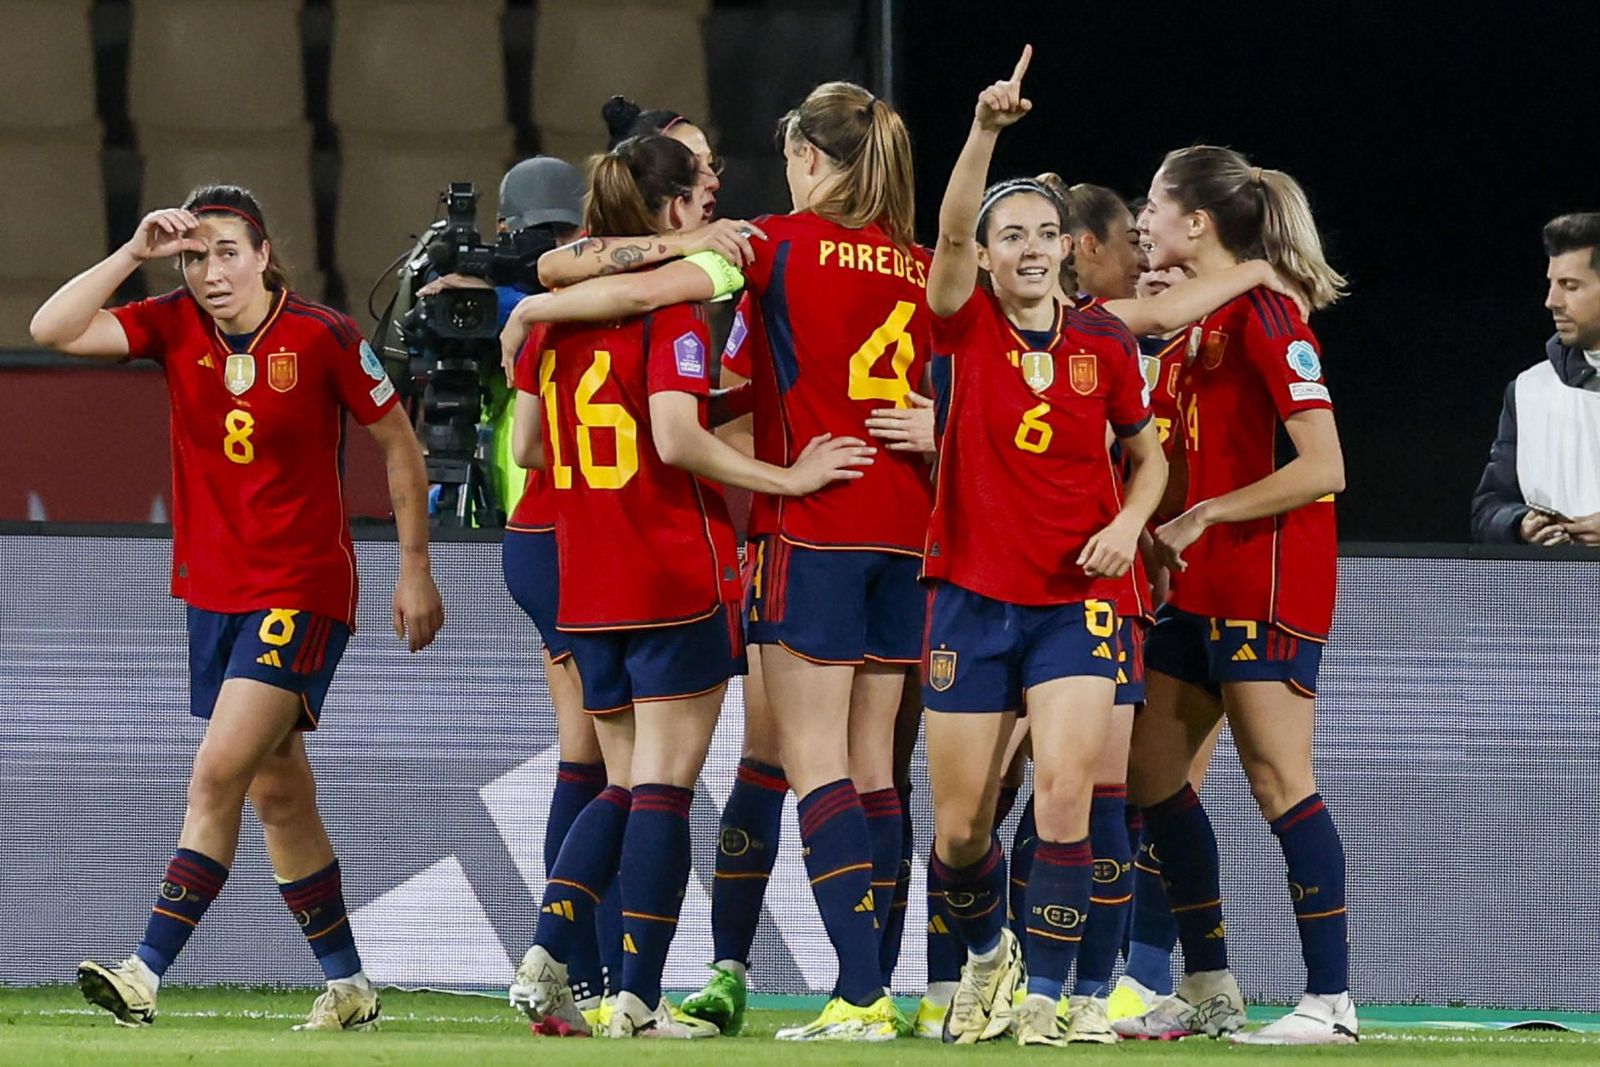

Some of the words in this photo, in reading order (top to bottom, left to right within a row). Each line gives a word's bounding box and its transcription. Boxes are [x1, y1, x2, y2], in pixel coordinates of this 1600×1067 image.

[819, 240, 926, 289] PAREDES
[848, 300, 917, 408] 4
[223, 408, 255, 465] 8
[538, 350, 639, 490] 16
[1014, 401, 1053, 454] 6
